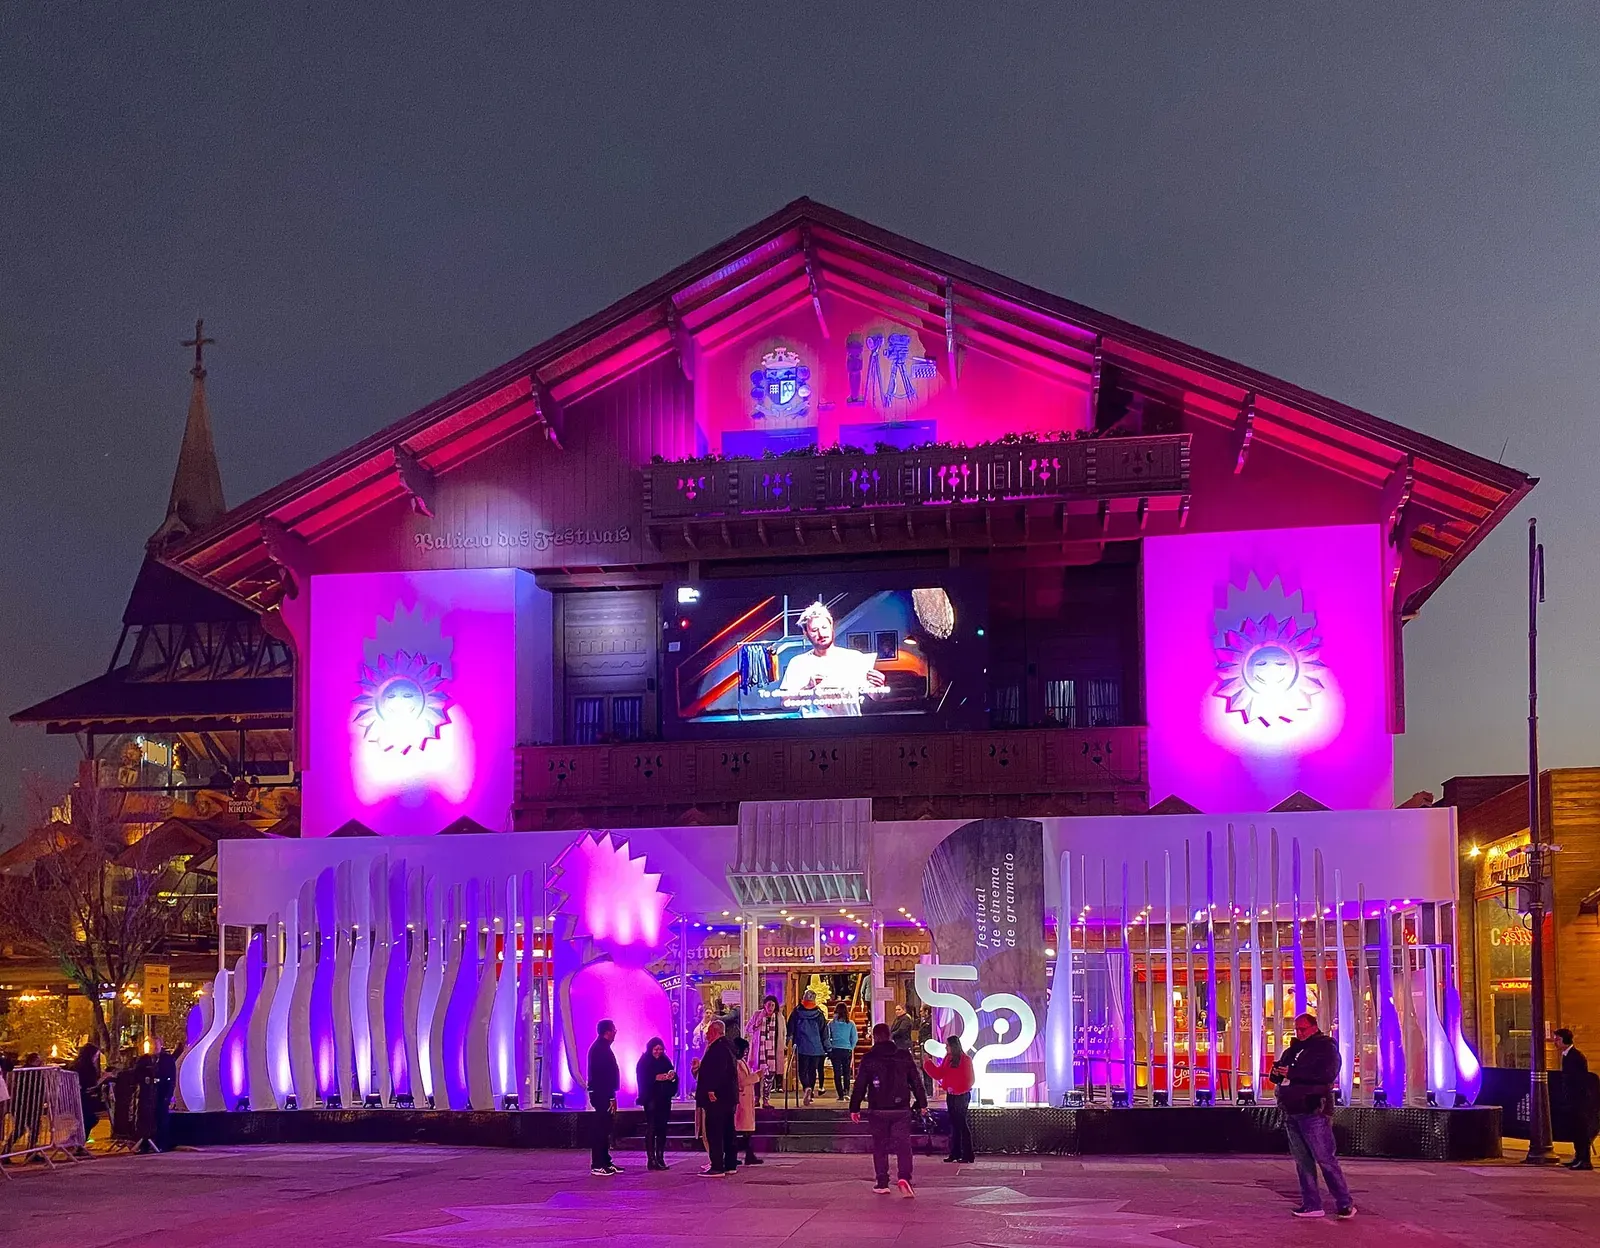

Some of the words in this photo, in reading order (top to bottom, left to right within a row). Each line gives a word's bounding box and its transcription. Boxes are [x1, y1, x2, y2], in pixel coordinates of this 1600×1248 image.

[413, 531, 492, 555] Palácio
[498, 528, 530, 547] dos
[533, 525, 631, 551] Festivais
[990, 866, 1001, 923] cinema
[1003, 852, 1017, 923] gramado
[976, 887, 989, 949] festival
[824, 943, 842, 957] de
[990, 929, 1001, 948] de
[1005, 929, 1015, 948] de
